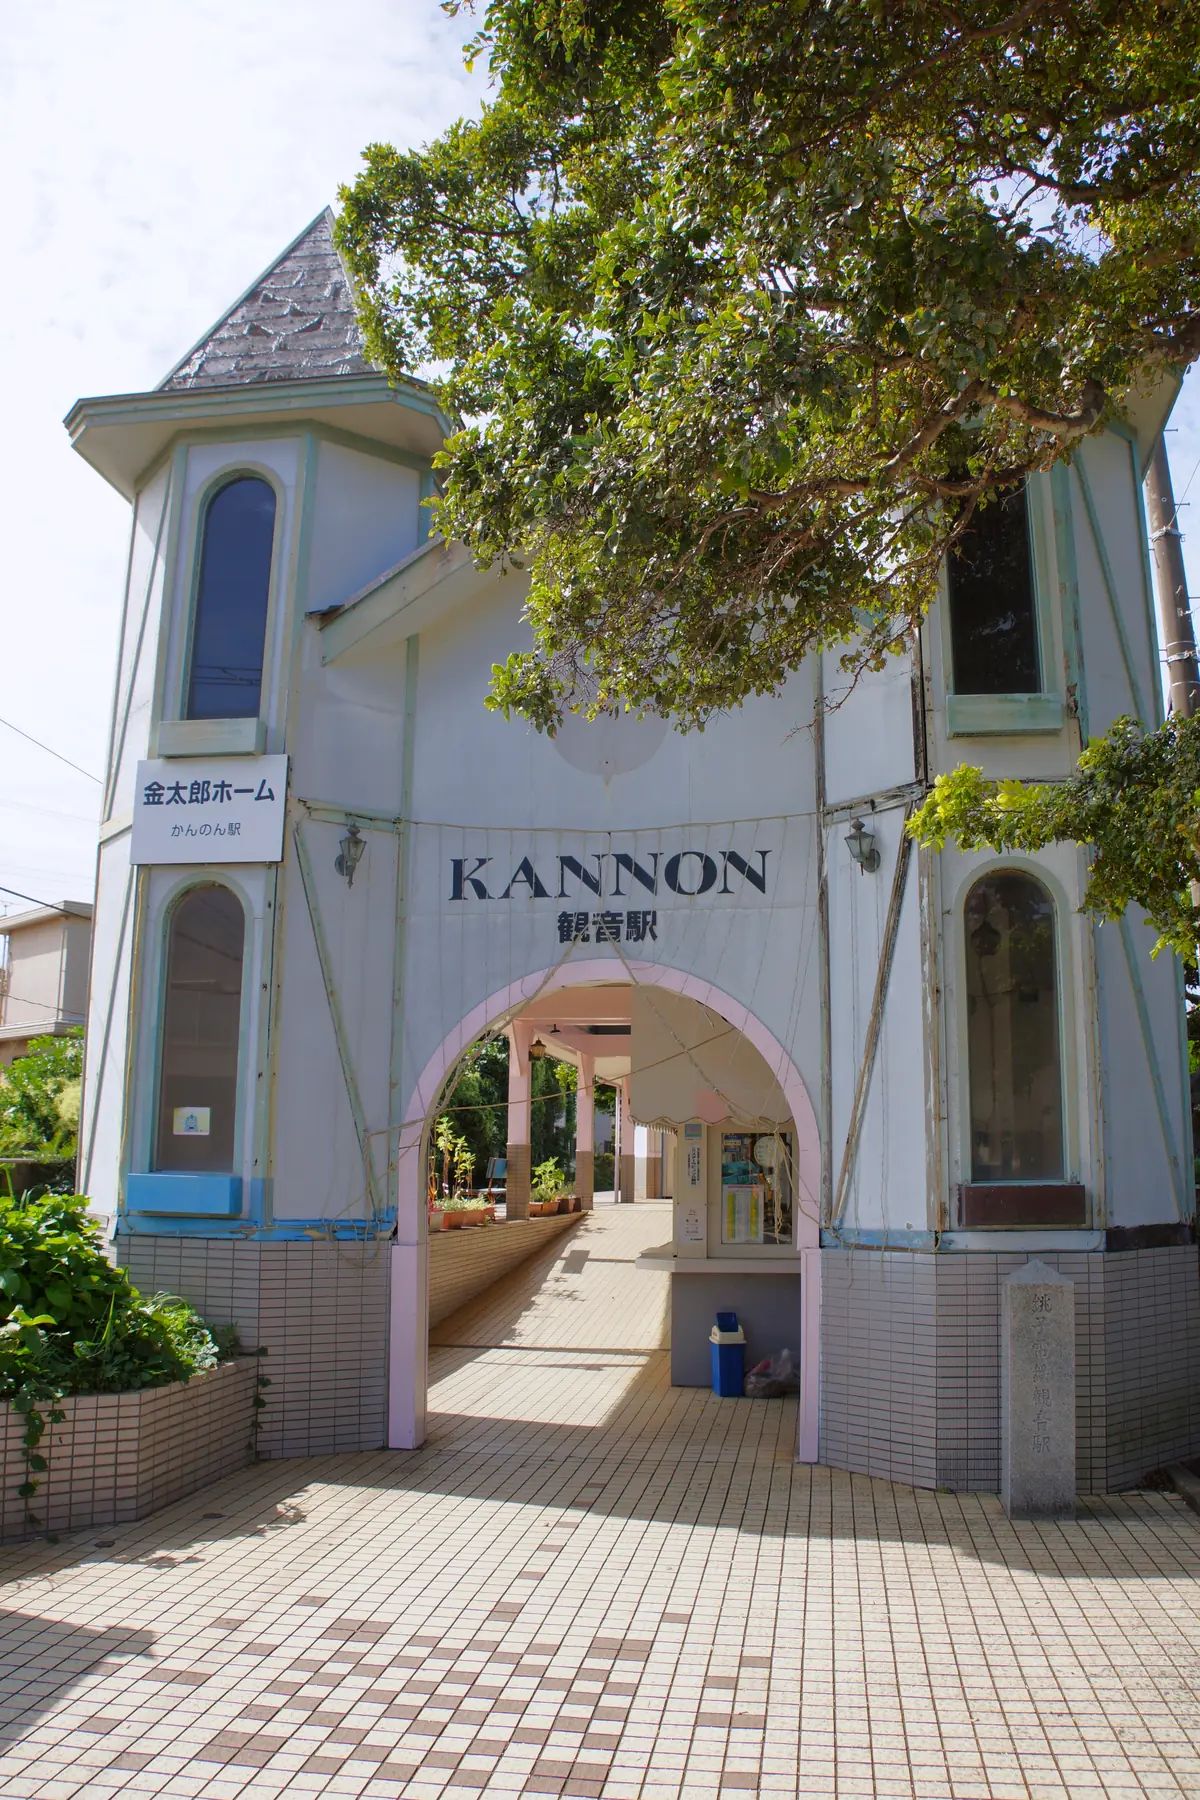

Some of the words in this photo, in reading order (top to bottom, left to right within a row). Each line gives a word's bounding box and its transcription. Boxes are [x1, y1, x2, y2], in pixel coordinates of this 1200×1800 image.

[143, 779, 275, 805] 金太郎ホーム
[170, 822, 241, 837] かんのん駅
[448, 850, 773, 900] KANNON
[557, 910, 658, 943] 観音駅
